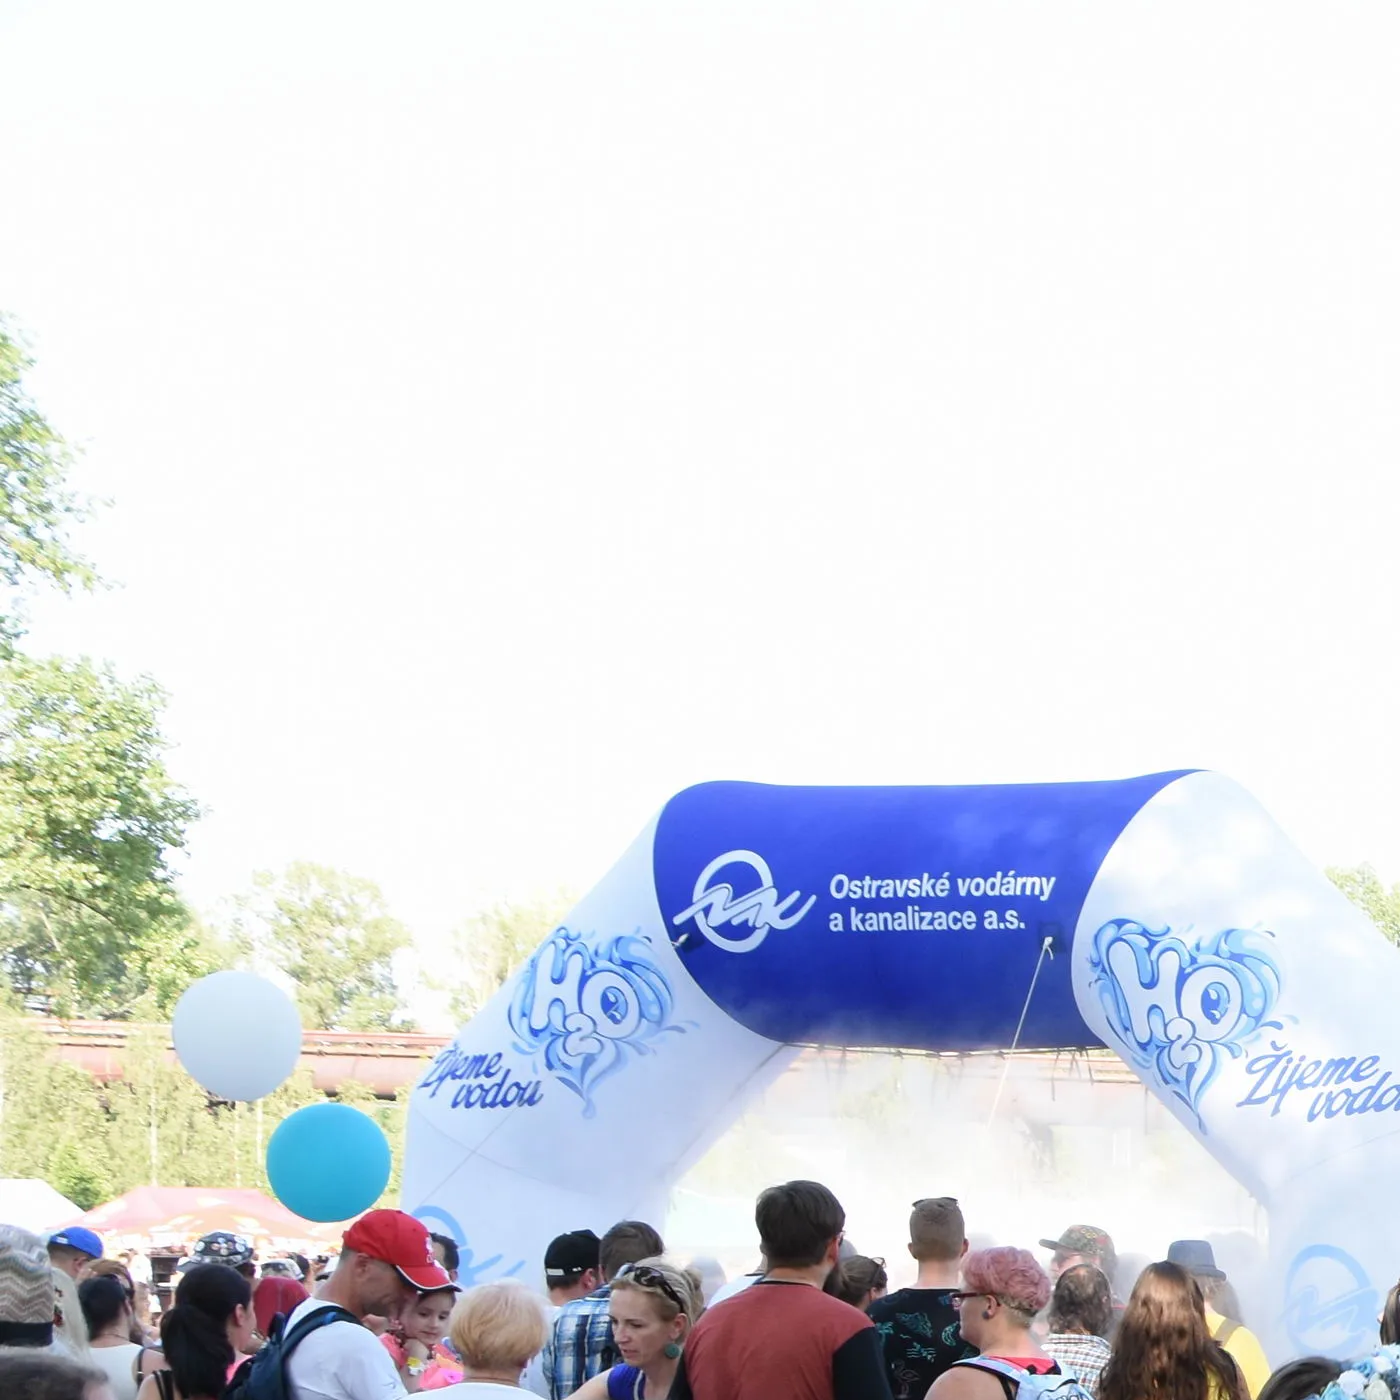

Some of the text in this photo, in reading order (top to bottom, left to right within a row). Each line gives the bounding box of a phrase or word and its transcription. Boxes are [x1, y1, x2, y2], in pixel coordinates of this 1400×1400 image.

[829, 870, 1057, 902] Ostravské vodárny
[828, 907, 1026, 932] a kanalizace a.s.
[450, 1068, 545, 1110] vodou
[1236, 1040, 1381, 1117] Žijeme
